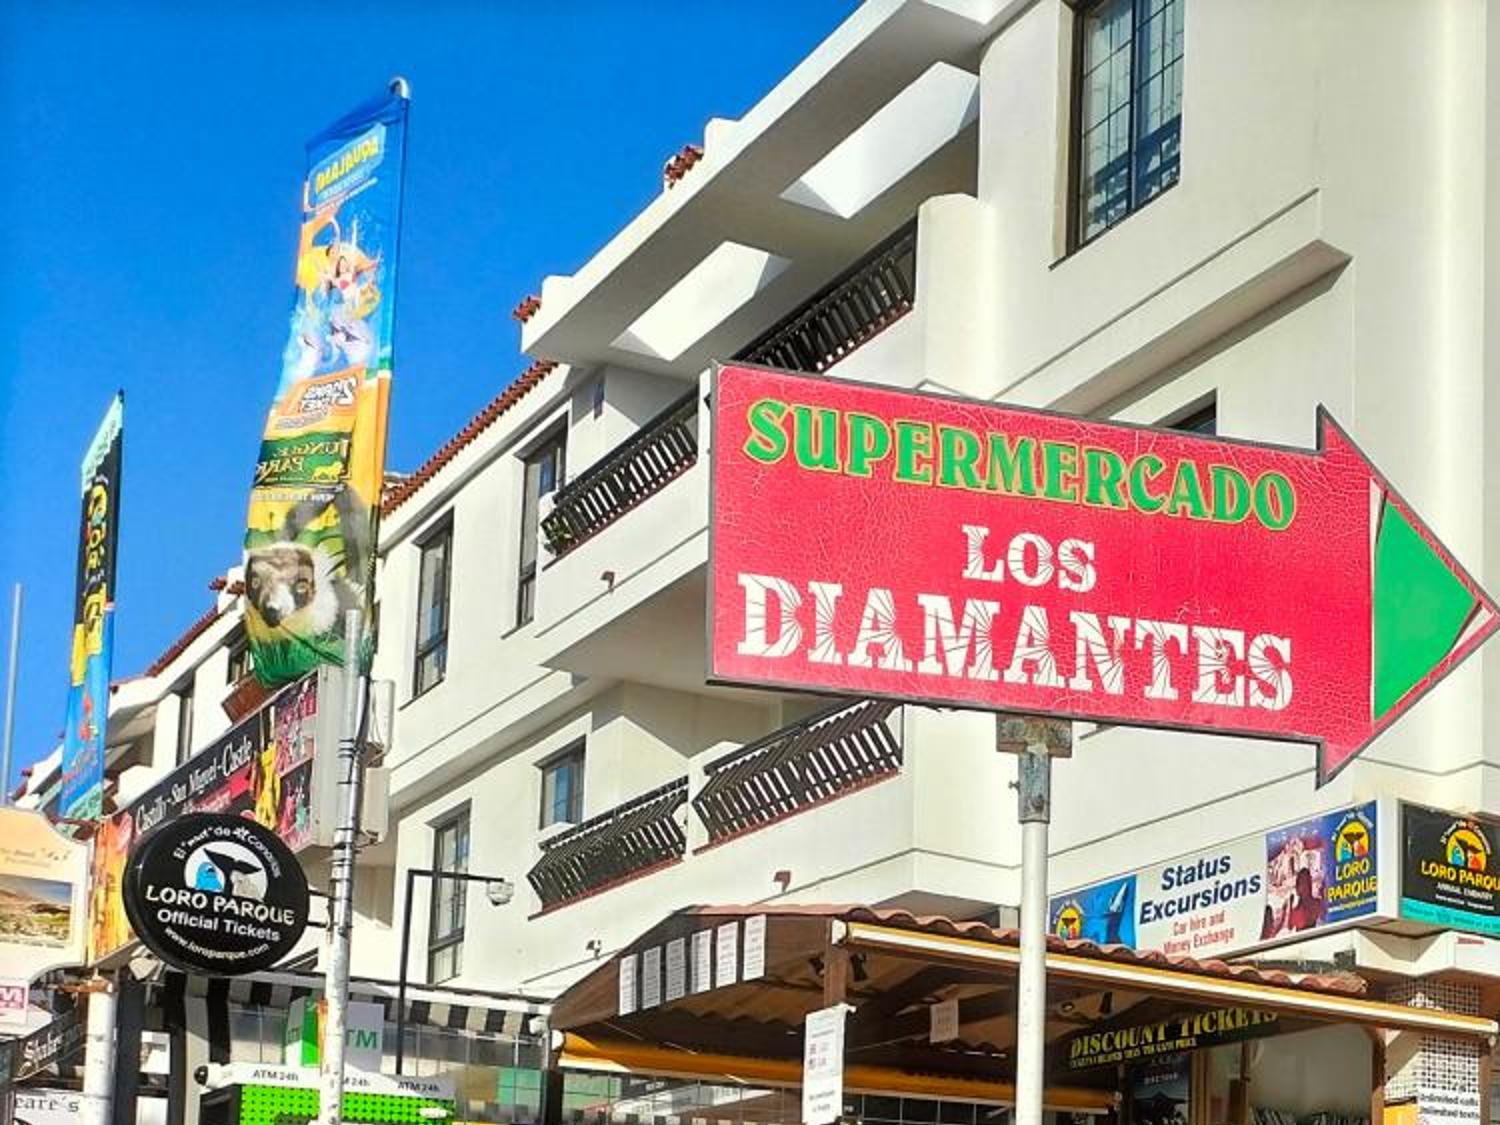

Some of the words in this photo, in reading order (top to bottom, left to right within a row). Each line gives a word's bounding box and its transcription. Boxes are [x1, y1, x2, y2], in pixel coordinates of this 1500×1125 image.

[742, 397, 1297, 531] SUPERMERCADO
[962, 525, 1097, 594] LOS
[736, 570, 1294, 713] DIAMANTES
[1161, 856, 1231, 891] Status
[1335, 858, 1371, 881] LORO
[1421, 860, 1456, 878] LORO
[145, 885, 207, 909] LORO
[213, 895, 295, 925] PARQUE
[1139, 875, 1262, 925] Excursions
[1327, 876, 1377, 902] PARQUE
[157, 909, 219, 931] Official
[223, 919, 281, 942] Tickets
[1071, 1024, 1168, 1058] DISCOUNT
[253, 1069, 277, 1079] ATM
